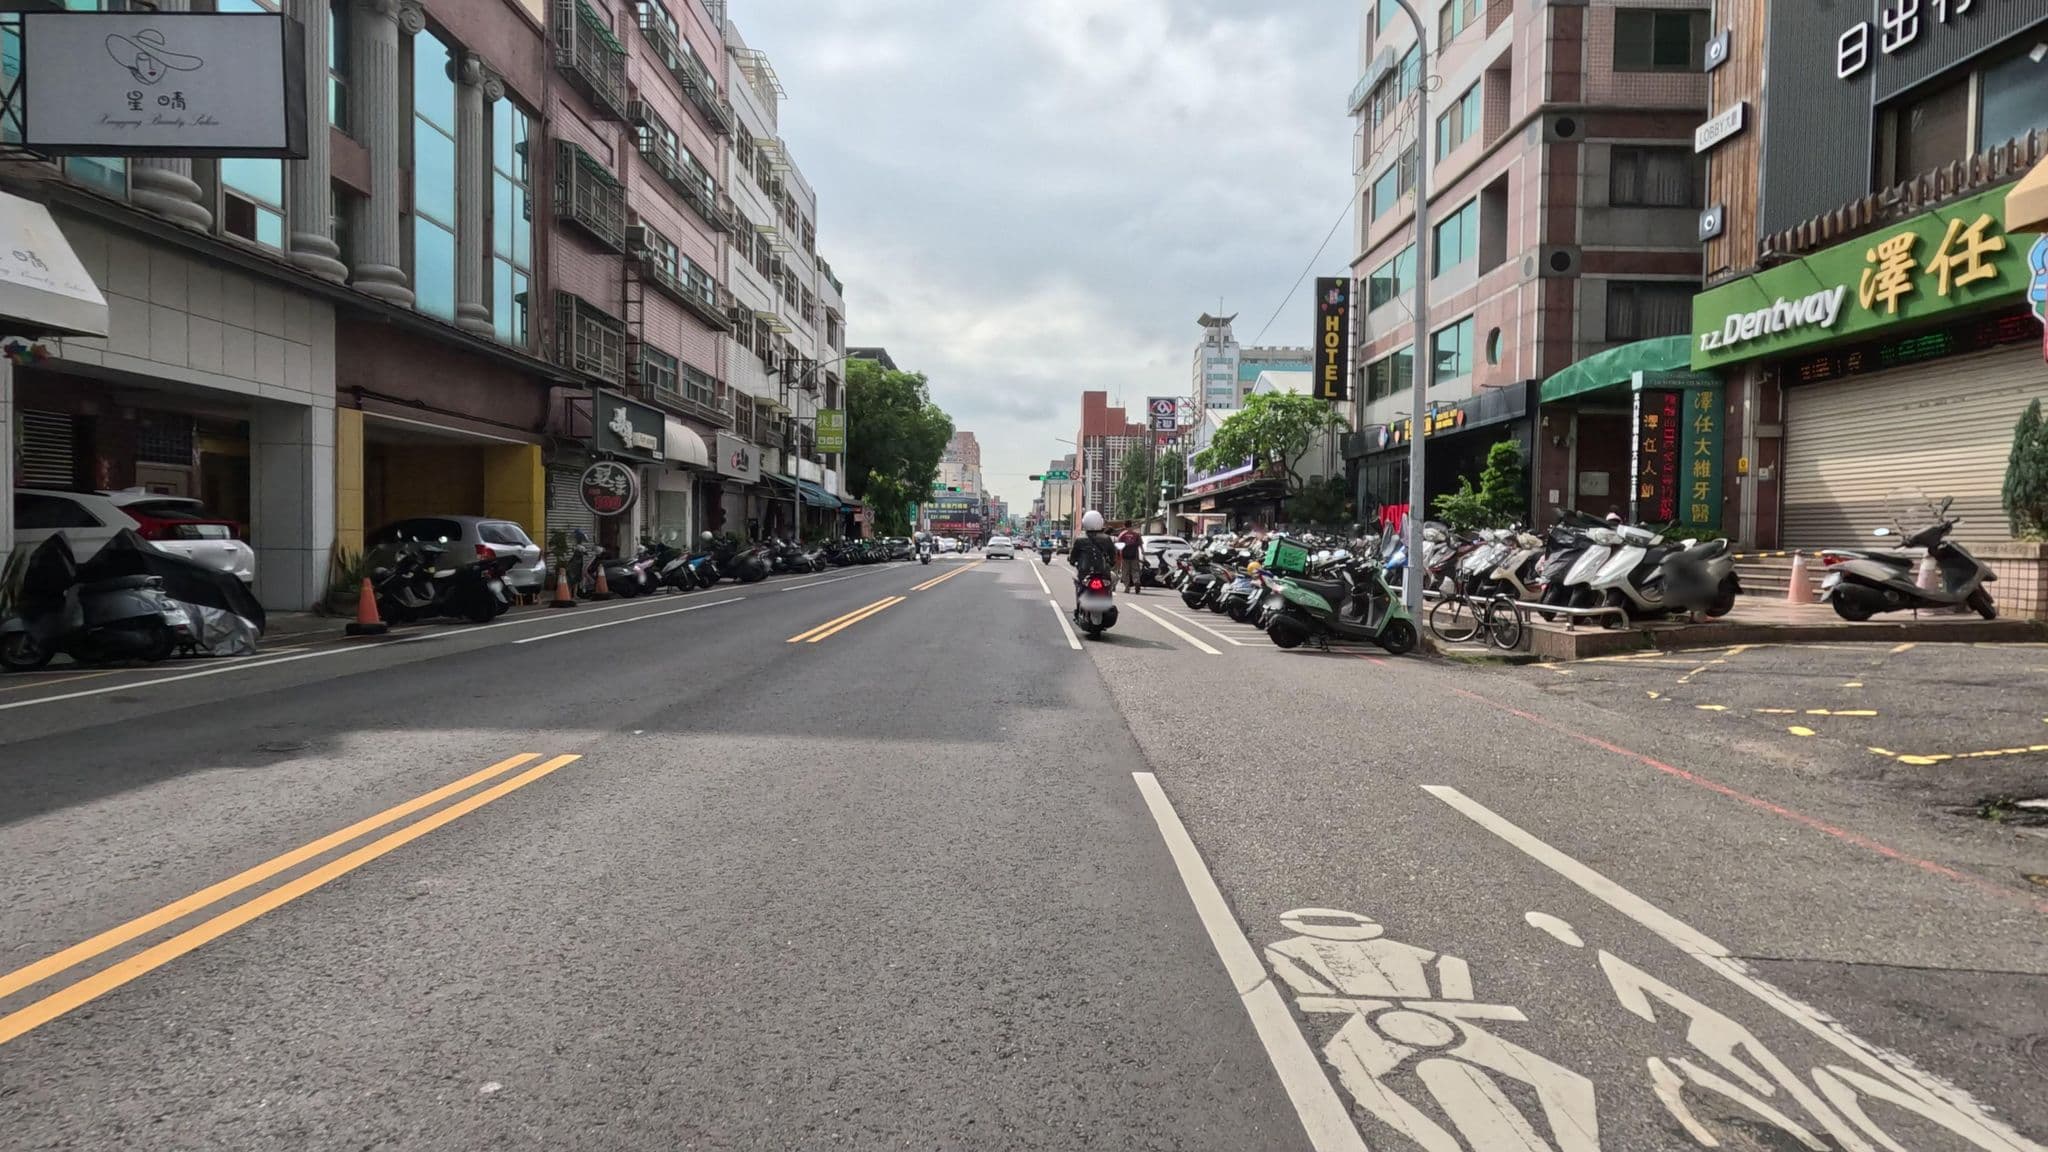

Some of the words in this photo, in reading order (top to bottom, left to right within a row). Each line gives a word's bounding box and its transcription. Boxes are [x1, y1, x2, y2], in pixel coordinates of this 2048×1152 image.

[1859, 213, 2006, 314] 澤任
[1324, 315, 1340, 397] HOTEL
[1691, 391, 1714, 523] 澤任大維牙醫
